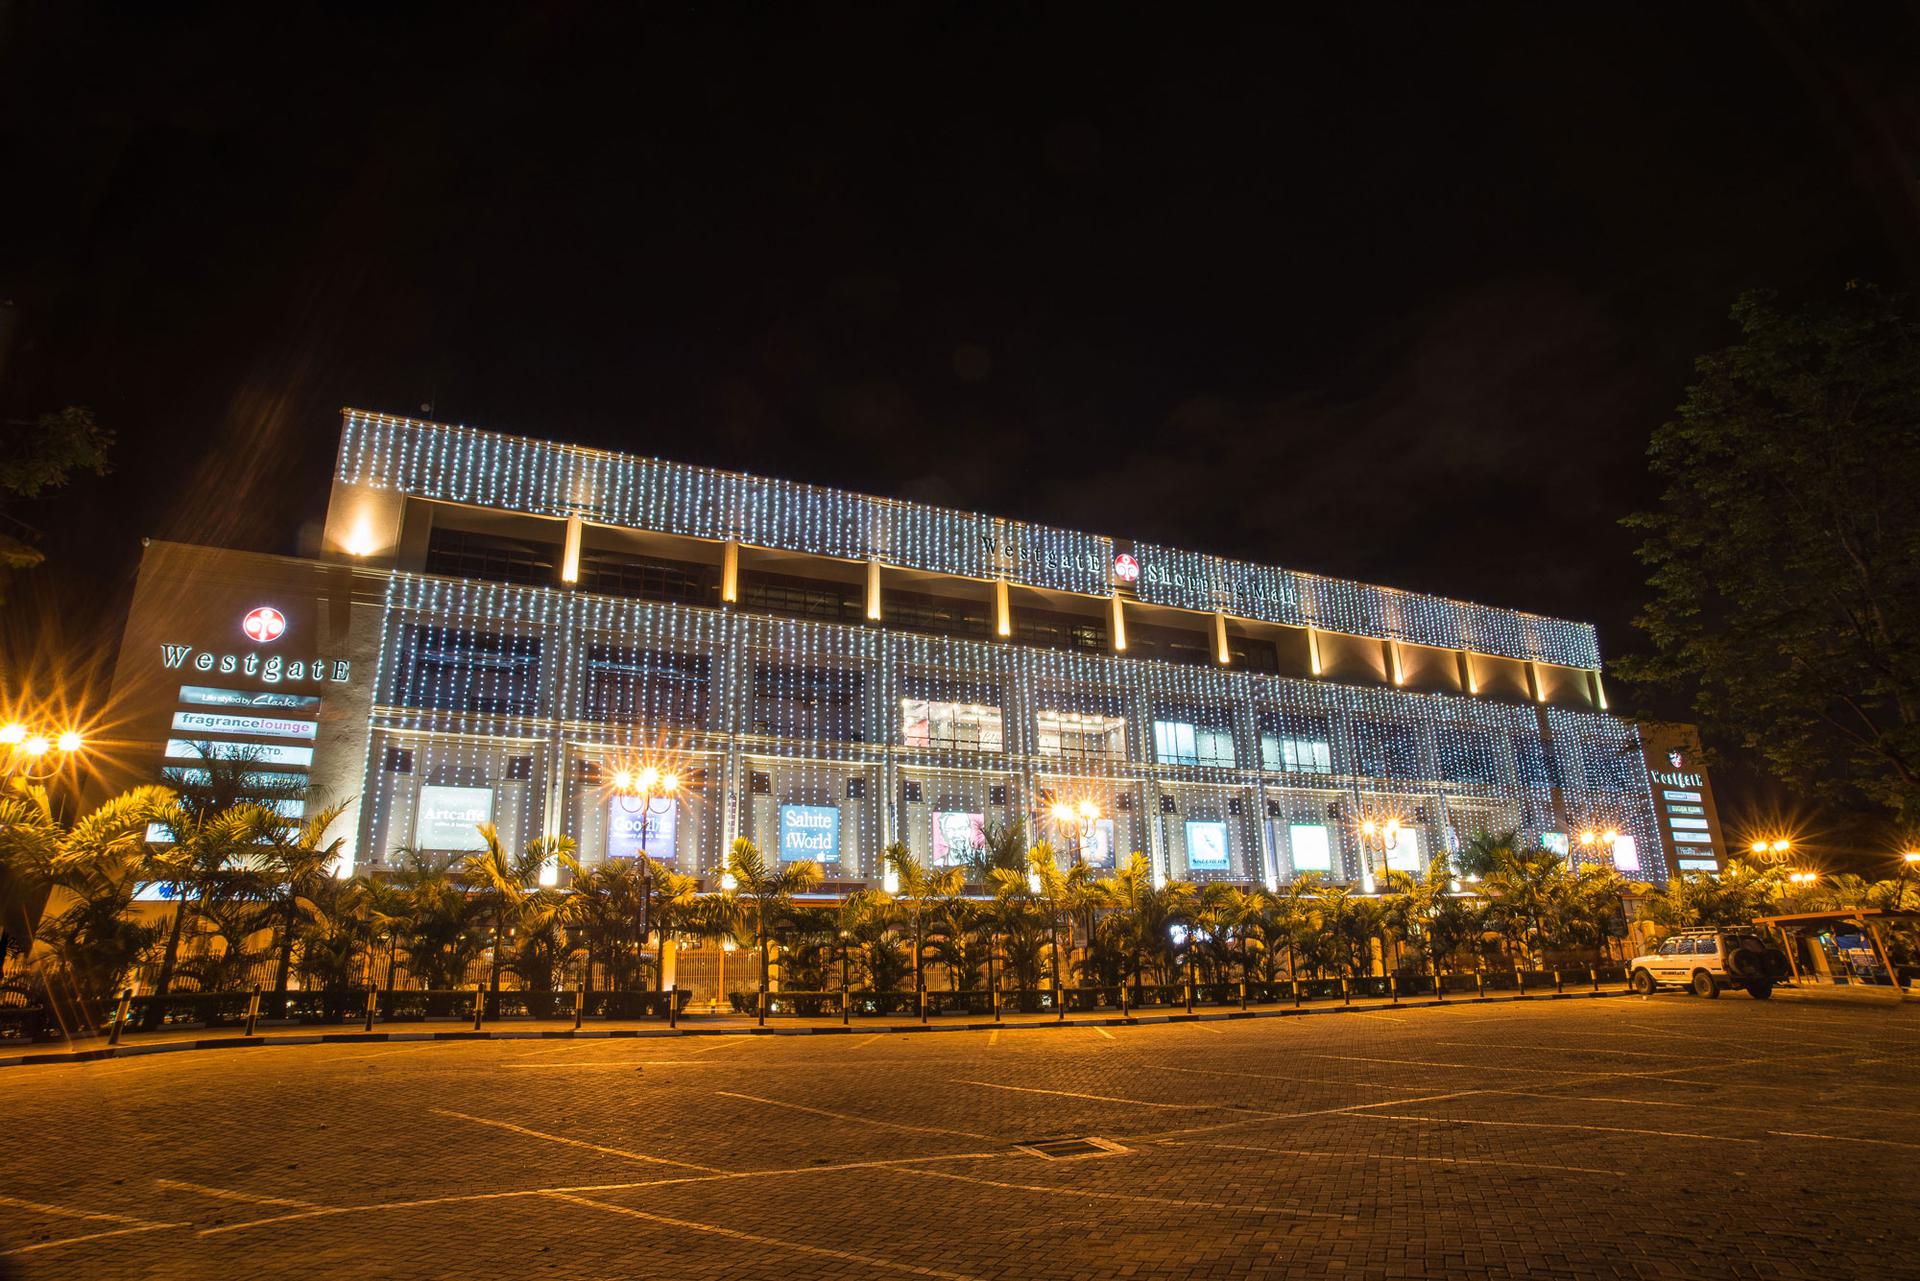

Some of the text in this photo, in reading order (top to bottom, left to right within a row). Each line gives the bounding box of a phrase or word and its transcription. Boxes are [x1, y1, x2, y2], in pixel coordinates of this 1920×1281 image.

[982, 536, 1297, 606] WestgatE Shopping Mall
[161, 643, 350, 683] WestgatE
[242, 696, 252, 706] by
[252, 694, 296, 707] Clarks
[785, 810, 832, 829] Salute
